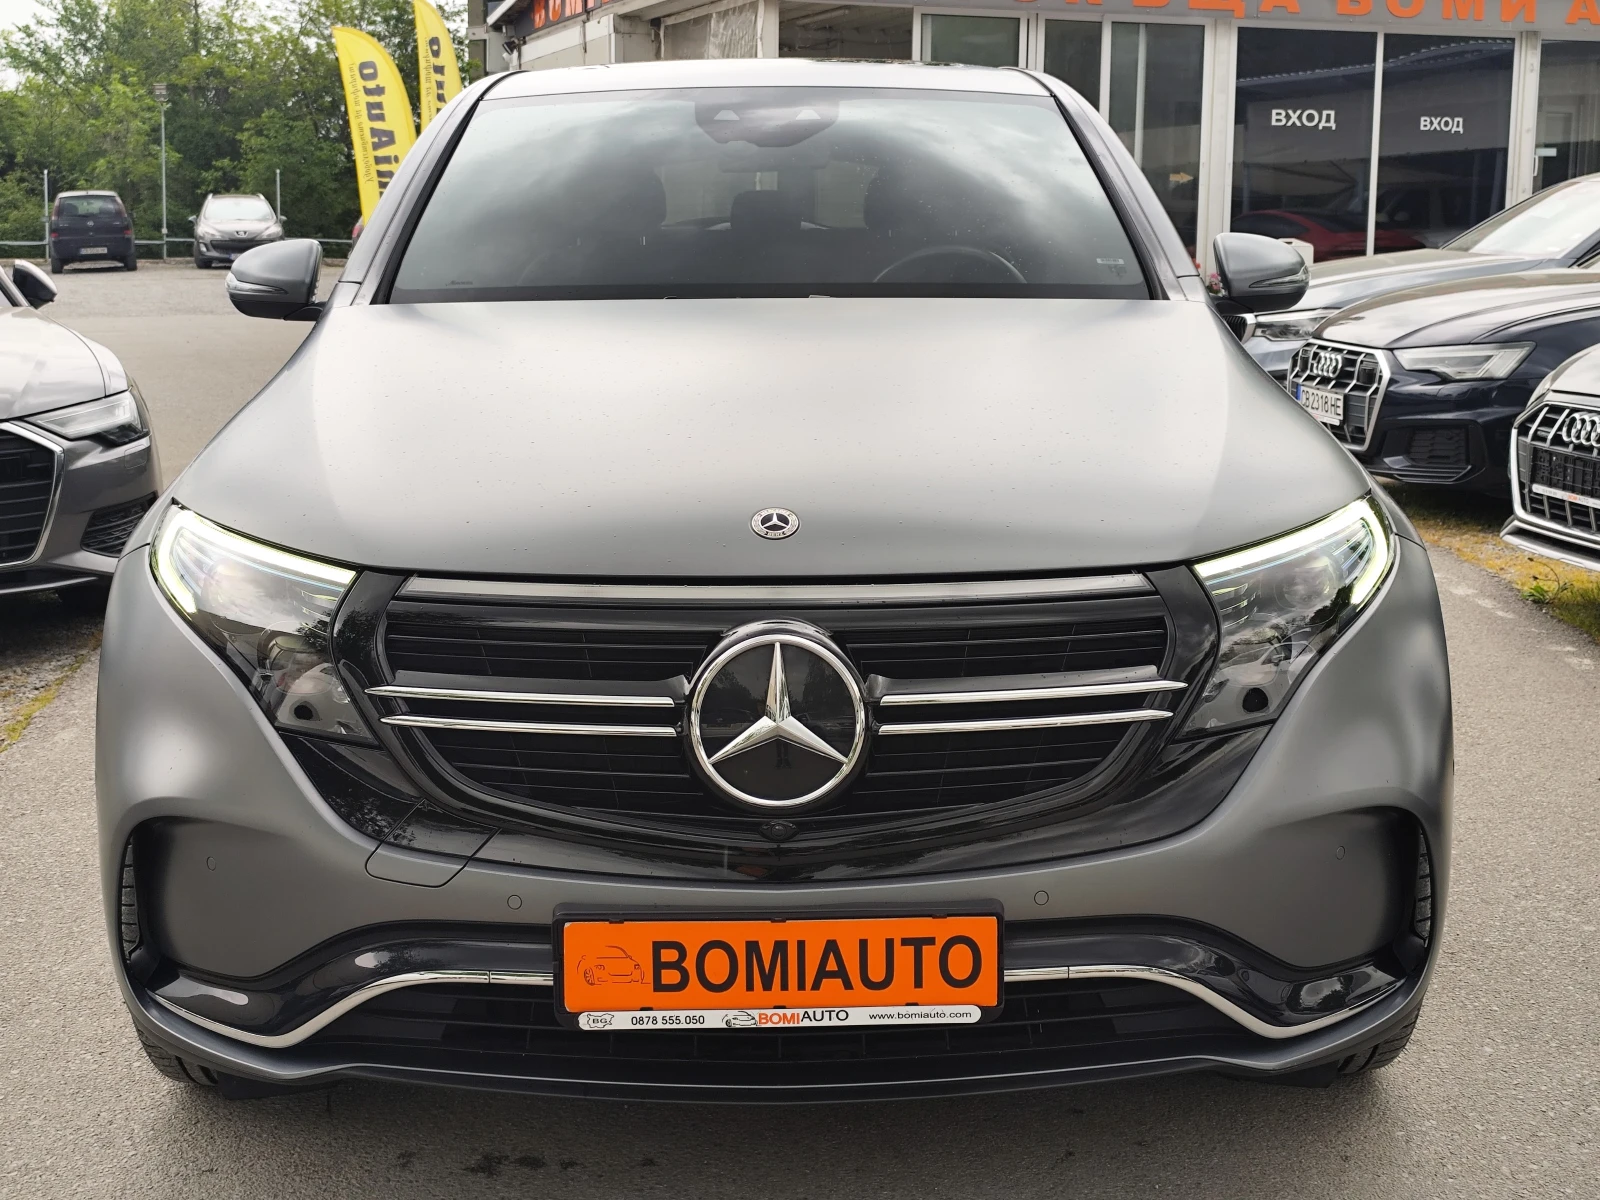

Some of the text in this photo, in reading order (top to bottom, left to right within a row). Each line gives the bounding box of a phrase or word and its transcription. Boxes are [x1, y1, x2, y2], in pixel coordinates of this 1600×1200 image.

[1271, 109, 1336, 130] ВХОД
[1420, 116, 1464, 134] ВХОД
[652, 935, 983, 993] BOMIAUTO
[631, 1015, 658, 1025] 0878
[661, 1014, 705, 1025] 555.050
[868, 1010, 972, 1021] www.bomiauto.com
